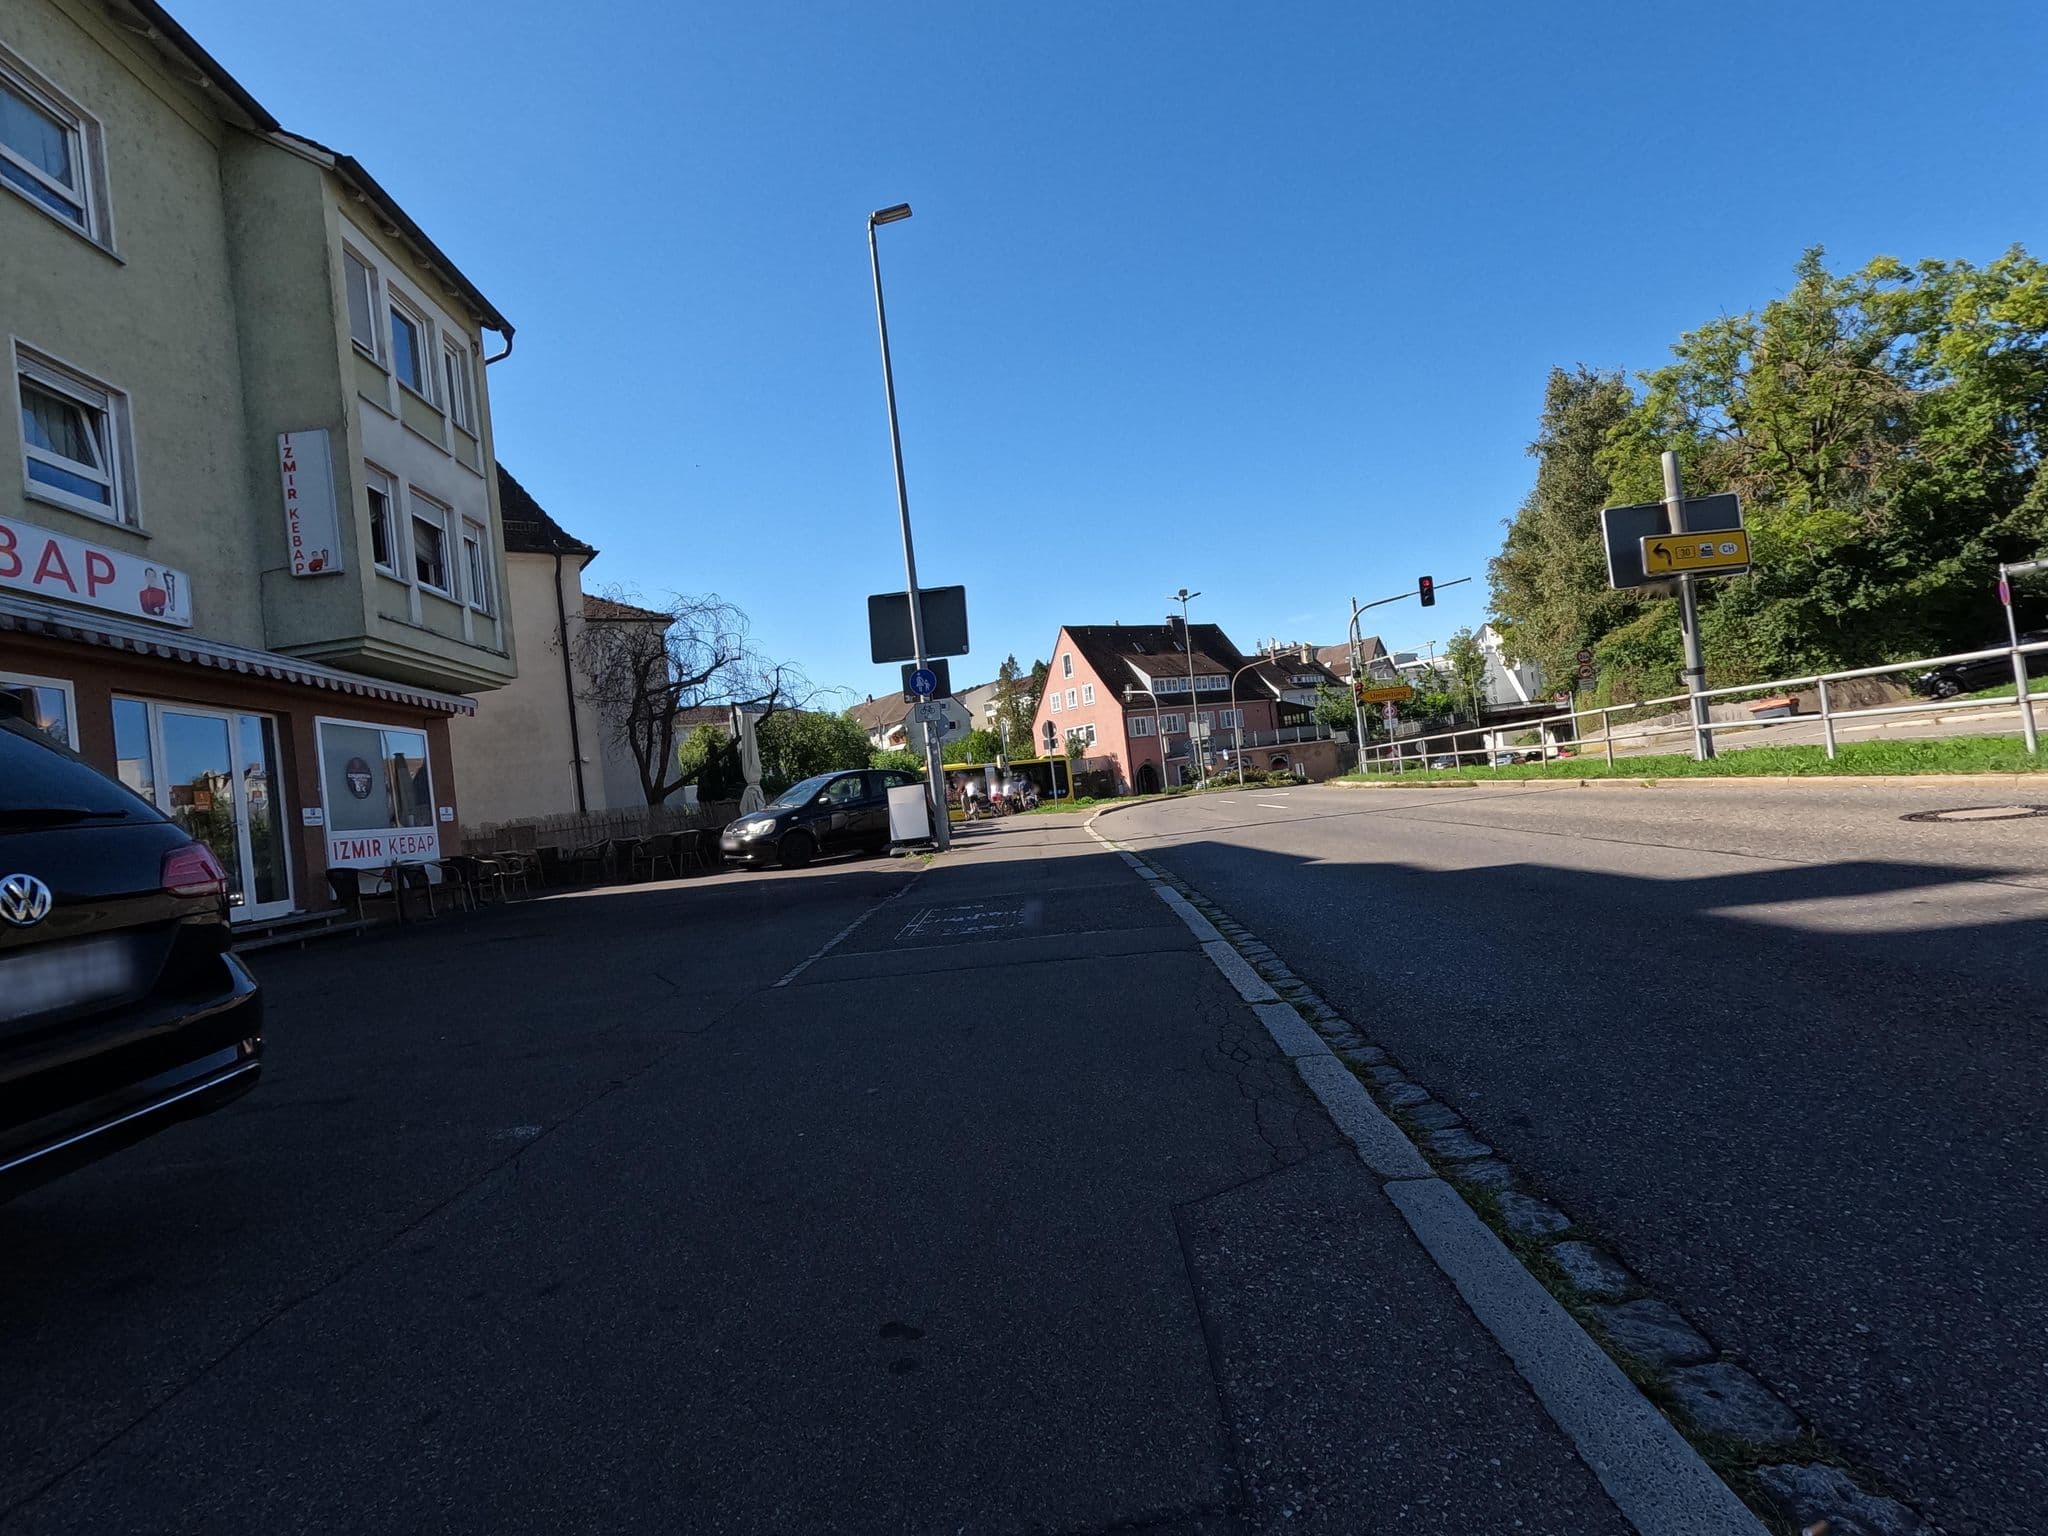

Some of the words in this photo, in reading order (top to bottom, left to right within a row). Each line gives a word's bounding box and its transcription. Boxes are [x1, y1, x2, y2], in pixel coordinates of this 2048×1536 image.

[289, 508, 304, 575] KEBAP
[1722, 544, 1735, 553] CH
[1370, 691, 1406, 699] Umleitung
[333, 840, 383, 861] IZMIR
[388, 835, 435, 855] KEBAP
